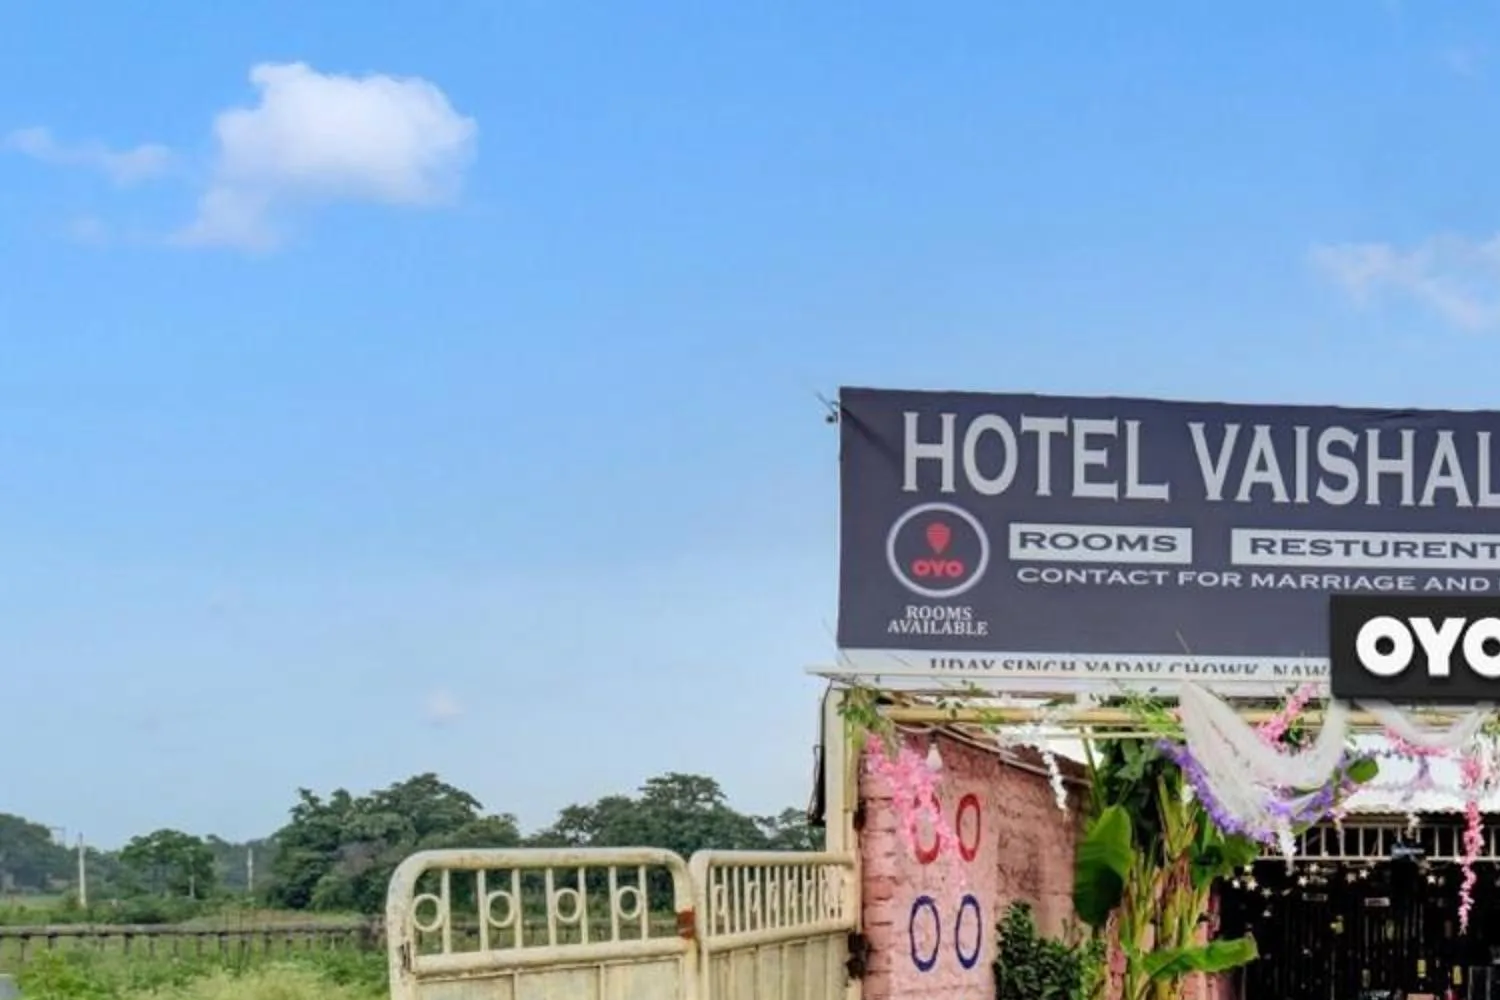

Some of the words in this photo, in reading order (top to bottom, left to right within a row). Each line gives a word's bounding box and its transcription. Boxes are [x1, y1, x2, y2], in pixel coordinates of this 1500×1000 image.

[902, 411, 1170, 501] HOTEL
[1019, 531, 1178, 553] ROOMS
[912, 559, 965, 578] OYO
[1017, 567, 1169, 586] CONTACT
[1178, 571, 1243, 588] FOR
[1250, 572, 1416, 591] MARRIAGE
[1423, 576, 1490, 592] AND
[906, 605, 973, 621] ROOMS
[887, 619, 989, 636] AVAILABLE
